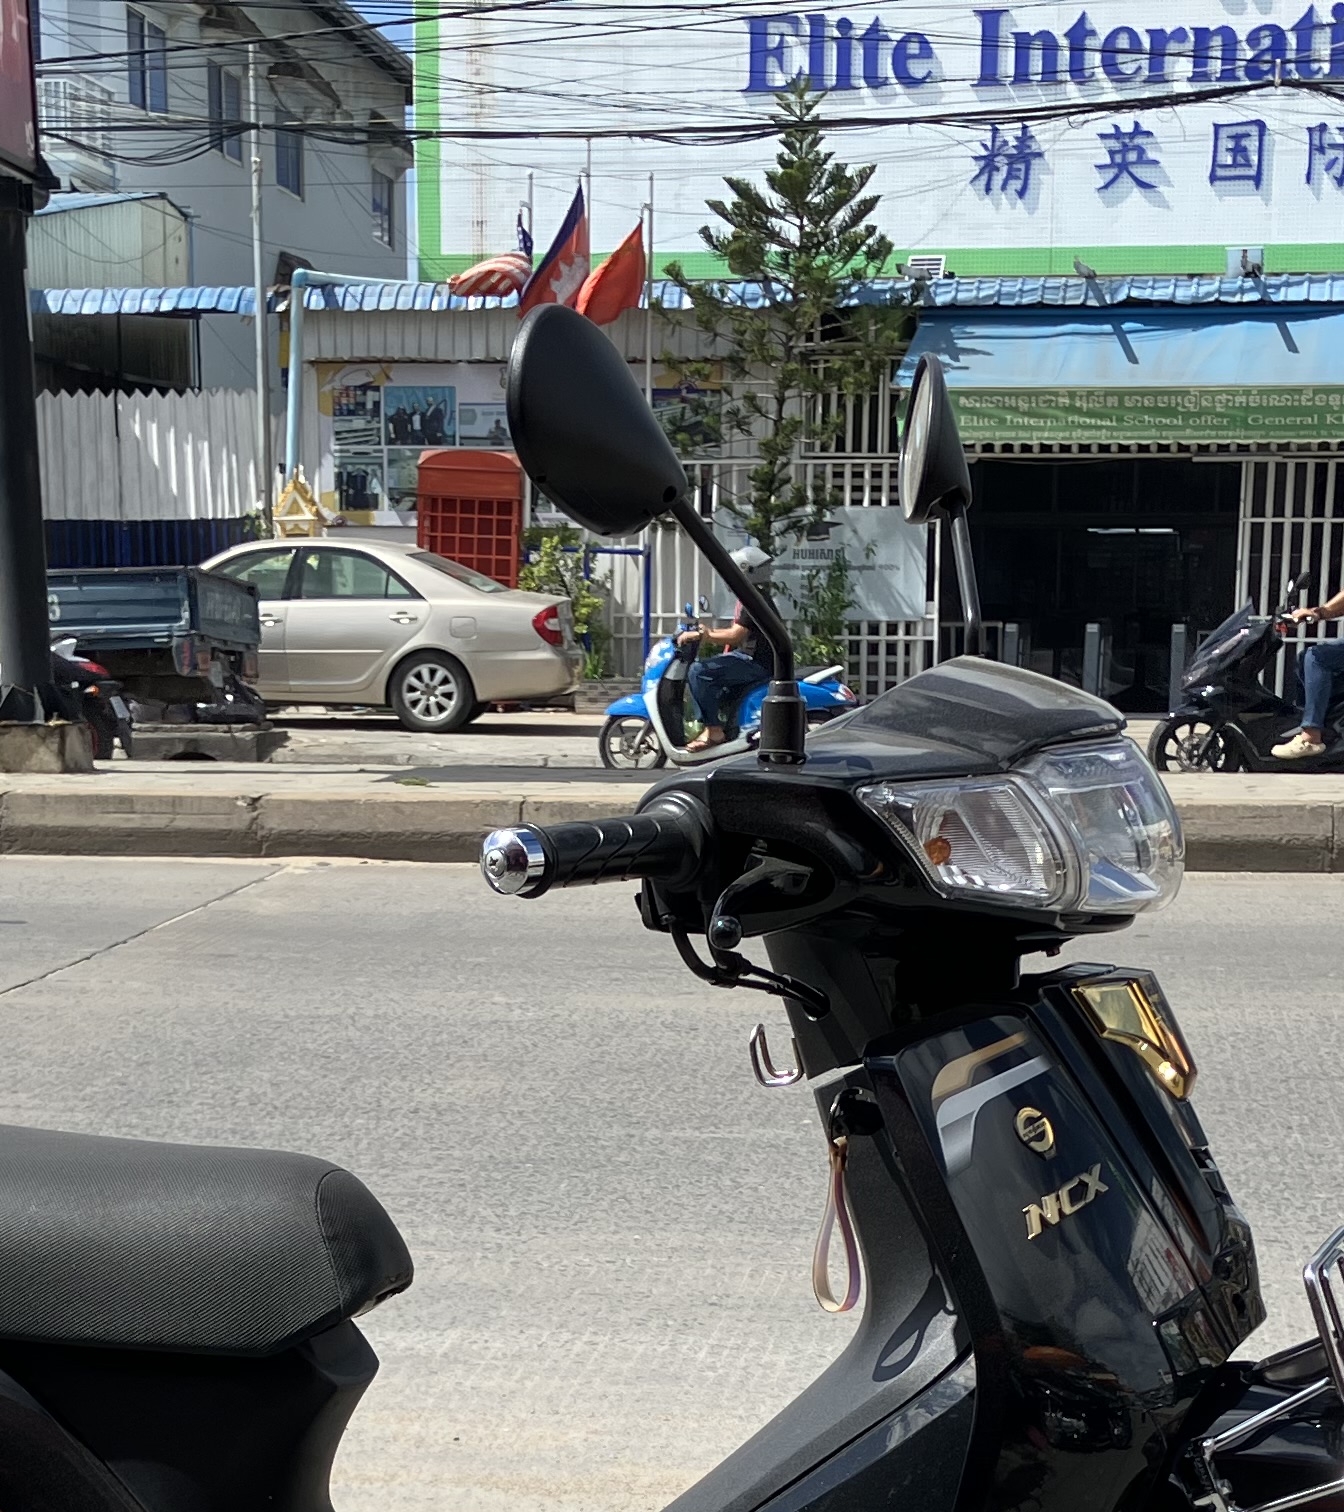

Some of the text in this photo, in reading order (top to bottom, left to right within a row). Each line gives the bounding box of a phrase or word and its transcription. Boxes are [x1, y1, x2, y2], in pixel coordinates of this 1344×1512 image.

[742, 13, 934, 92] Elite
[960, 415, 999, 427] Elite
[1006, 415, 1117, 427] International
[1123, 415, 1183, 427] School
[1189, 414, 1230, 426] offer
[1248, 414, 1318, 426] General
[1022, 1163, 1109, 1241] NCX
